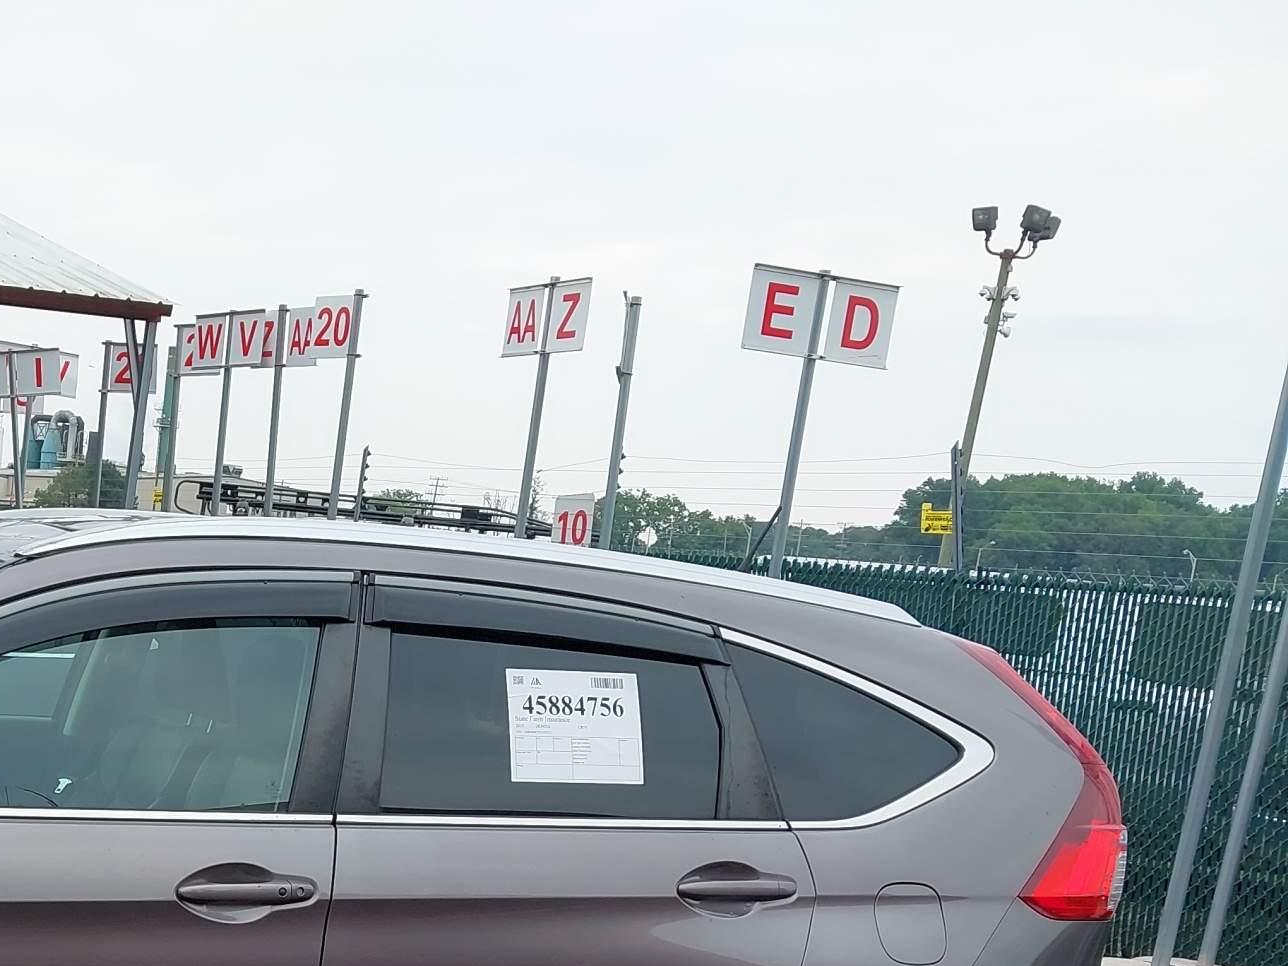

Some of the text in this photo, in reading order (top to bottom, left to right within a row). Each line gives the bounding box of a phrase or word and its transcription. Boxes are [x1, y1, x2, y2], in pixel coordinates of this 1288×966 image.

[313, 307, 351, 347] 20
[507, 299, 536, 344] AA
[556, 292, 581, 339] Z
[761, 281, 800, 340] E
[840, 295, 880, 350] D
[197, 323, 223, 360] W
[240, 319, 258, 357] V
[558, 509, 588, 545] 10
[522, 694, 625, 718] 45884756
